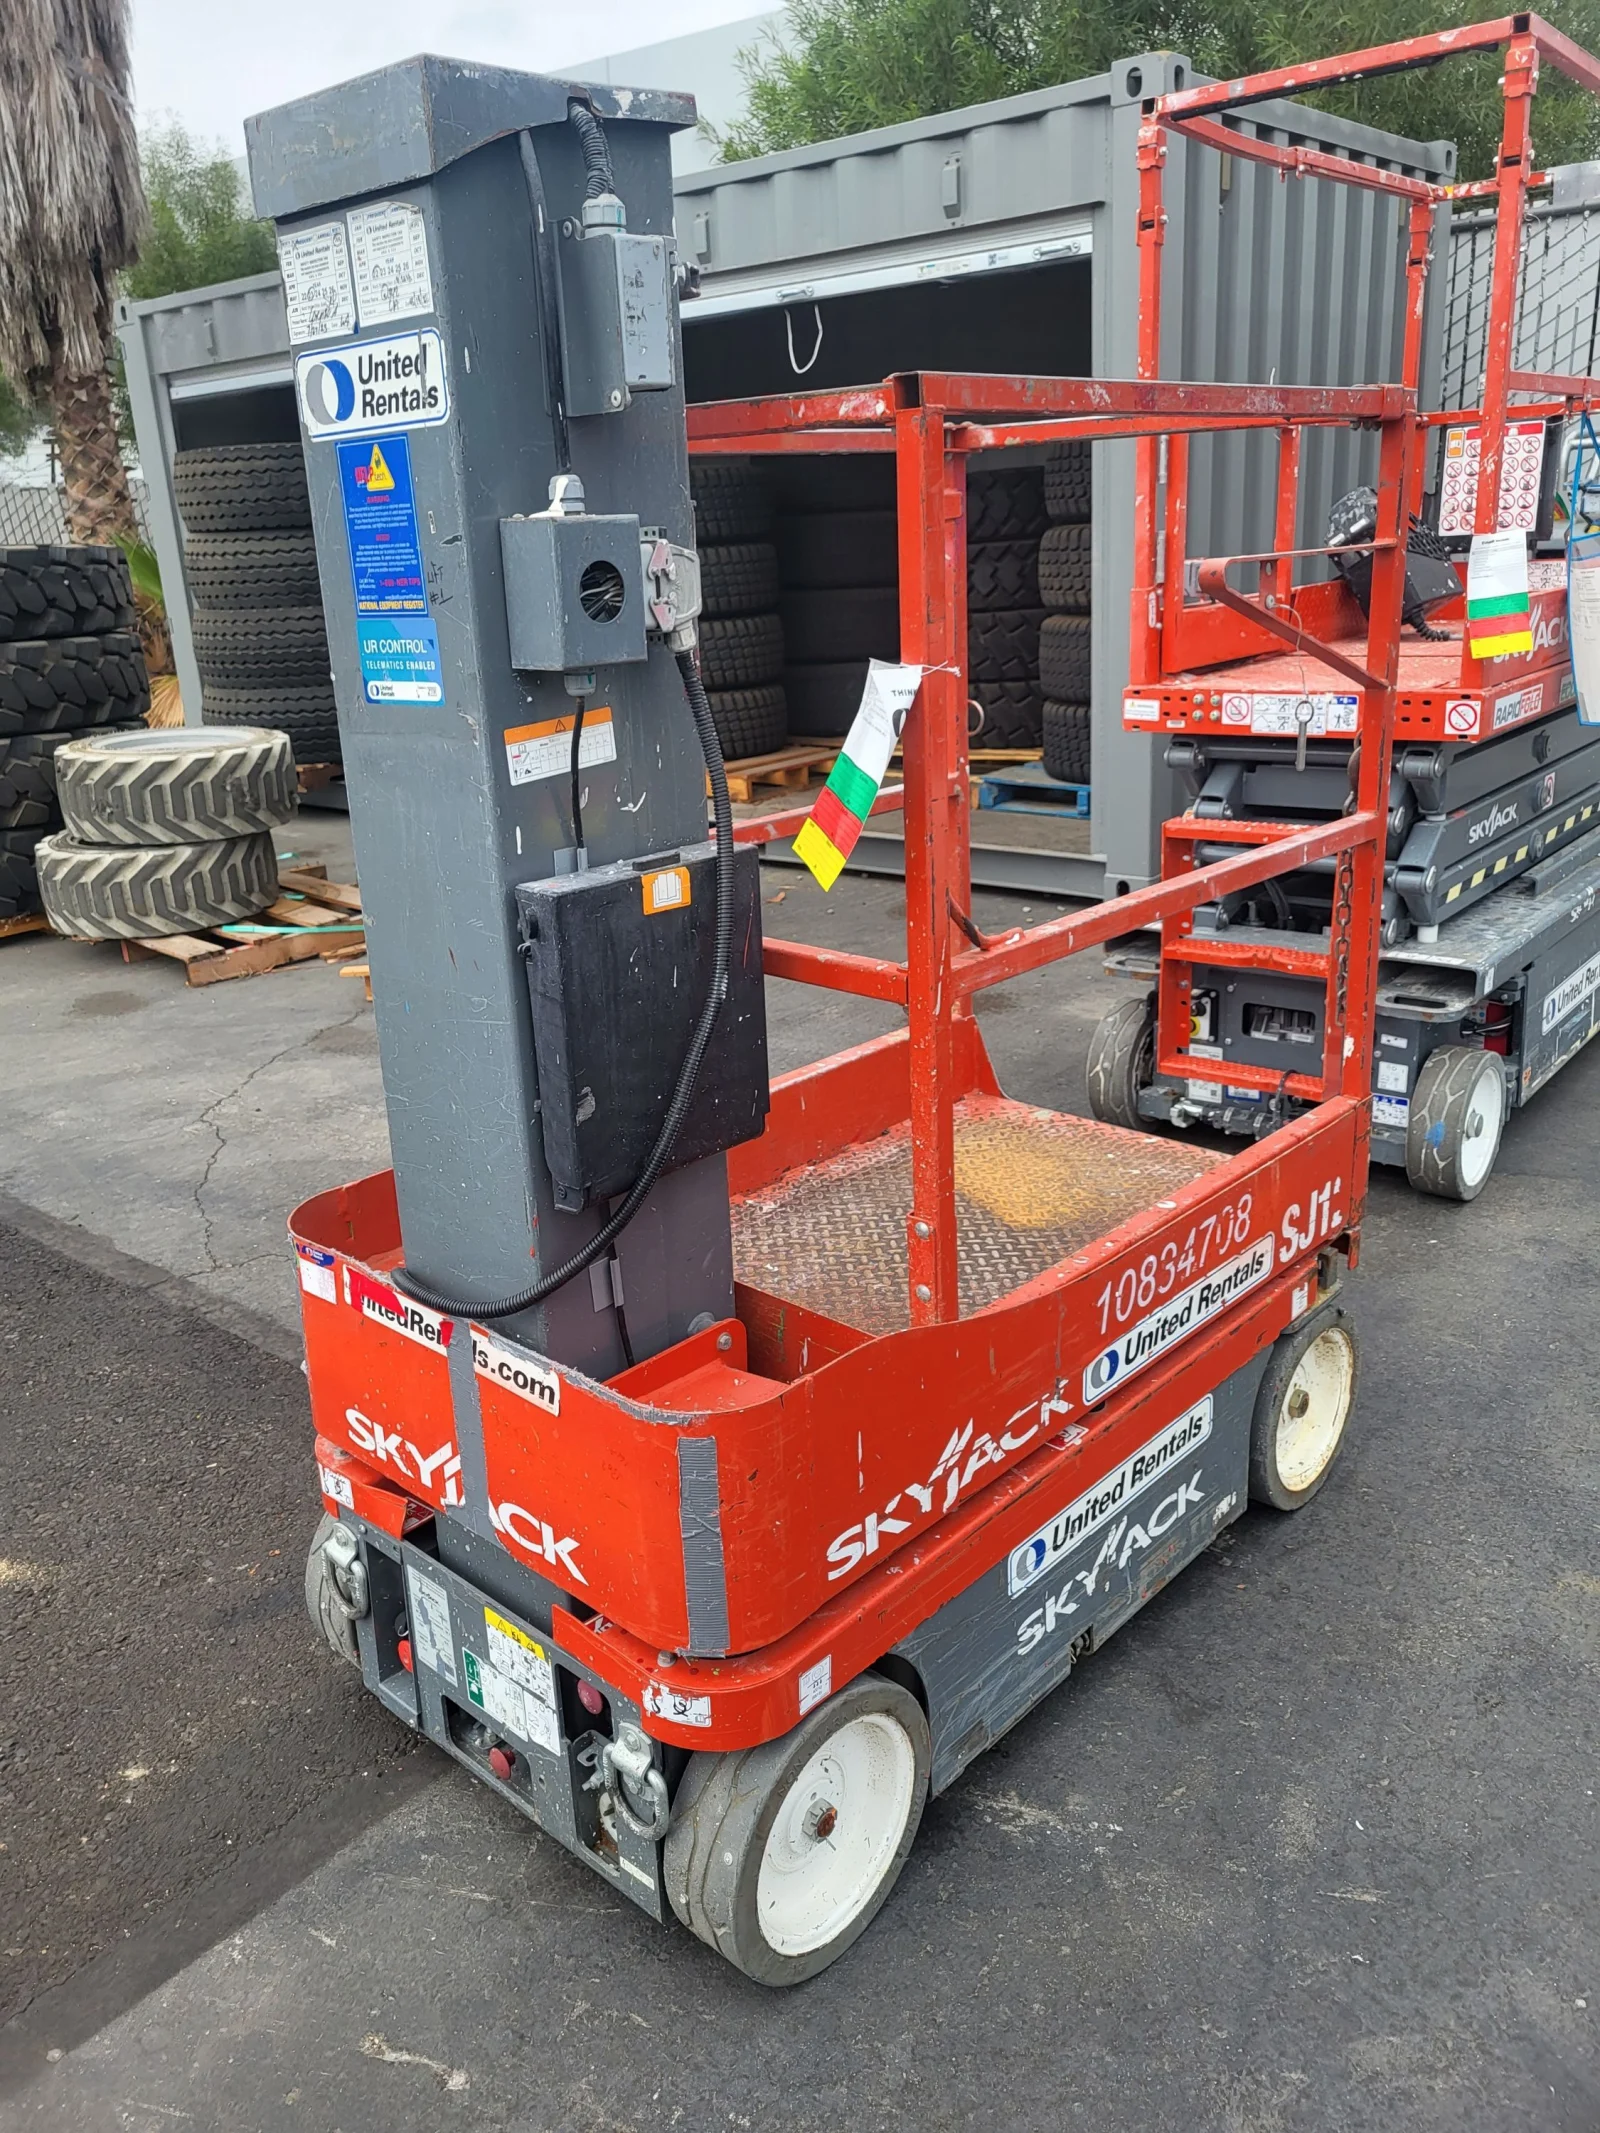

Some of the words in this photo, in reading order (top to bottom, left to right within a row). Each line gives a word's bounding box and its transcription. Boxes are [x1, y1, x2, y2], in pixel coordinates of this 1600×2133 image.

[358, 342, 428, 385] United
[363, 640, 379, 654] UR
[380, 640, 428, 654] CONTROL
[366, 660, 404, 670] TELEMATICS
[406, 660, 436, 671] ENABLED
[1469, 802, 1518, 845] SKYJACK
[1557, 972, 1585, 1014] United
[1124, 1295, 1193, 1366] United
[1197, 1251, 1266, 1315] Rentals
[1052, 1478, 1126, 1554] United
[1132, 1414, 1204, 1483] Rentals
